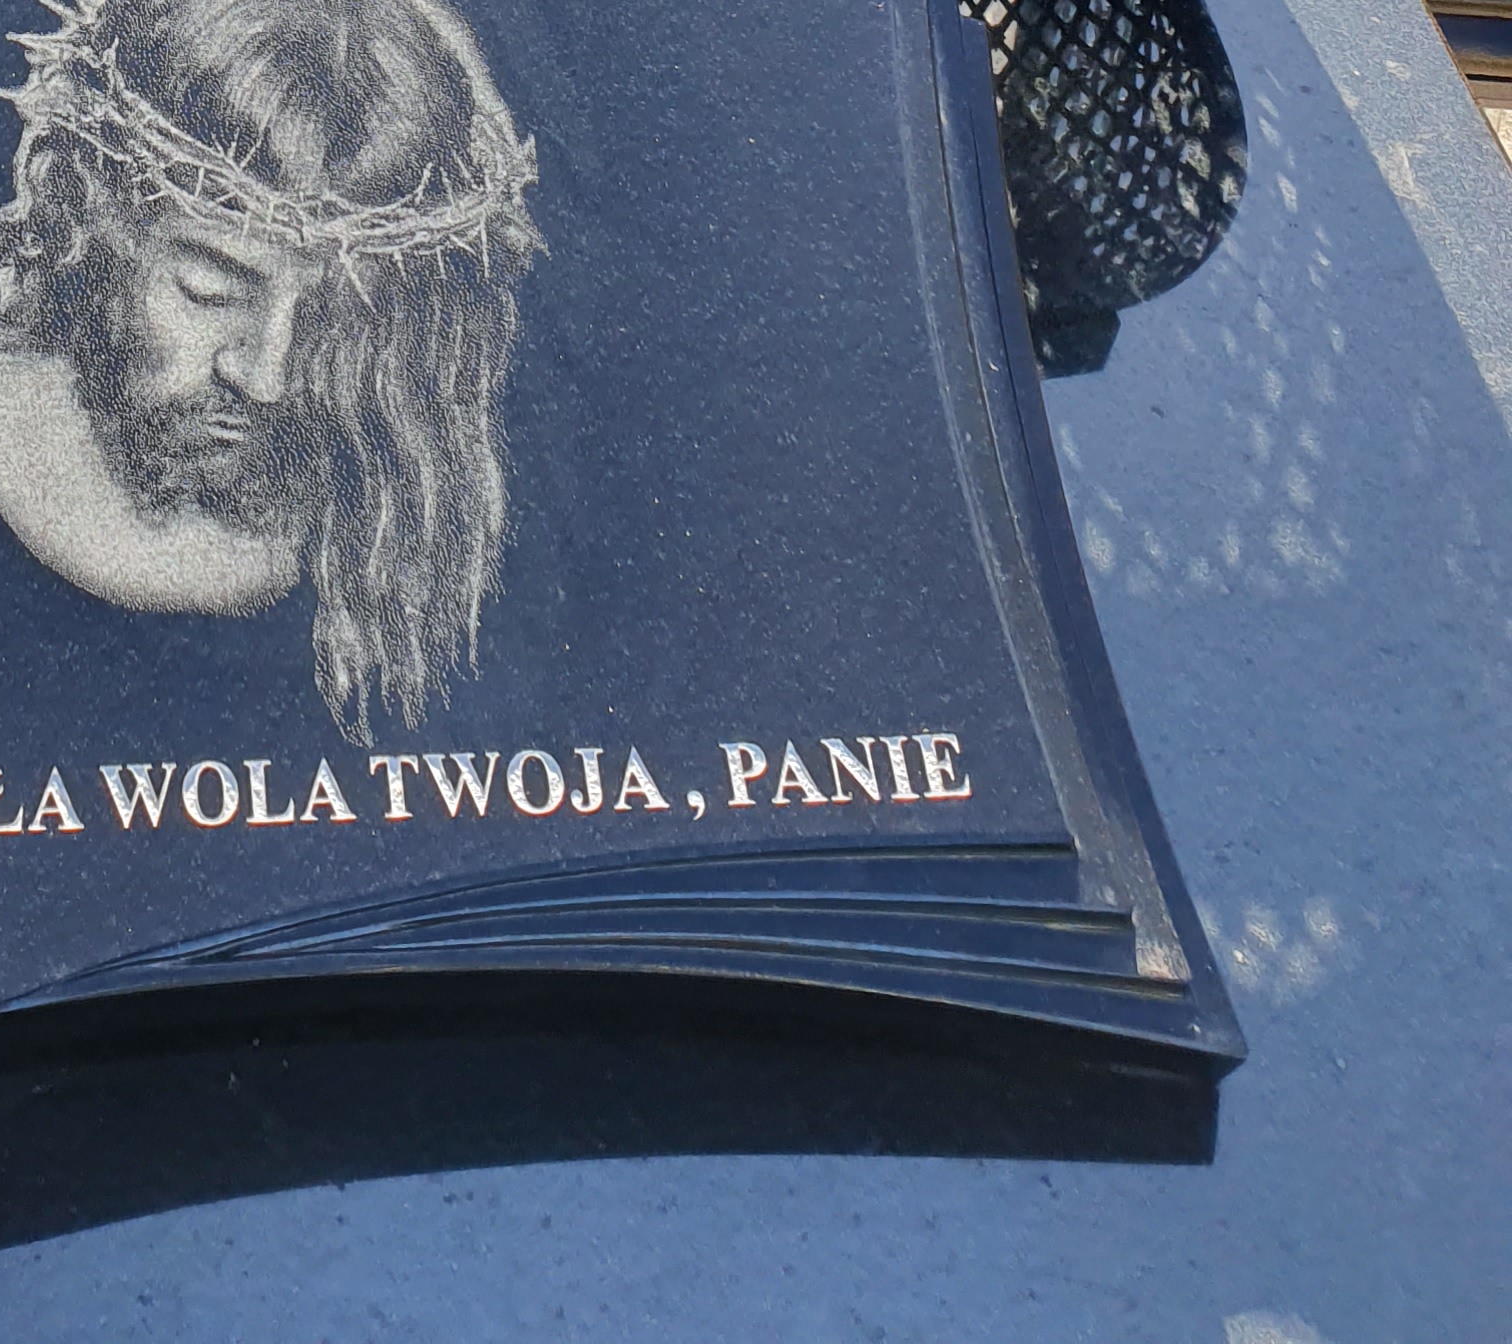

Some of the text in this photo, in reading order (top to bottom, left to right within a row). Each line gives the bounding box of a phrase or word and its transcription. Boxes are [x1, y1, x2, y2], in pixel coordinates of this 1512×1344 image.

[98, 755, 357, 831] WOLA
[368, 744, 671, 821] TWOJA
[718, 730, 974, 808] PANIE
